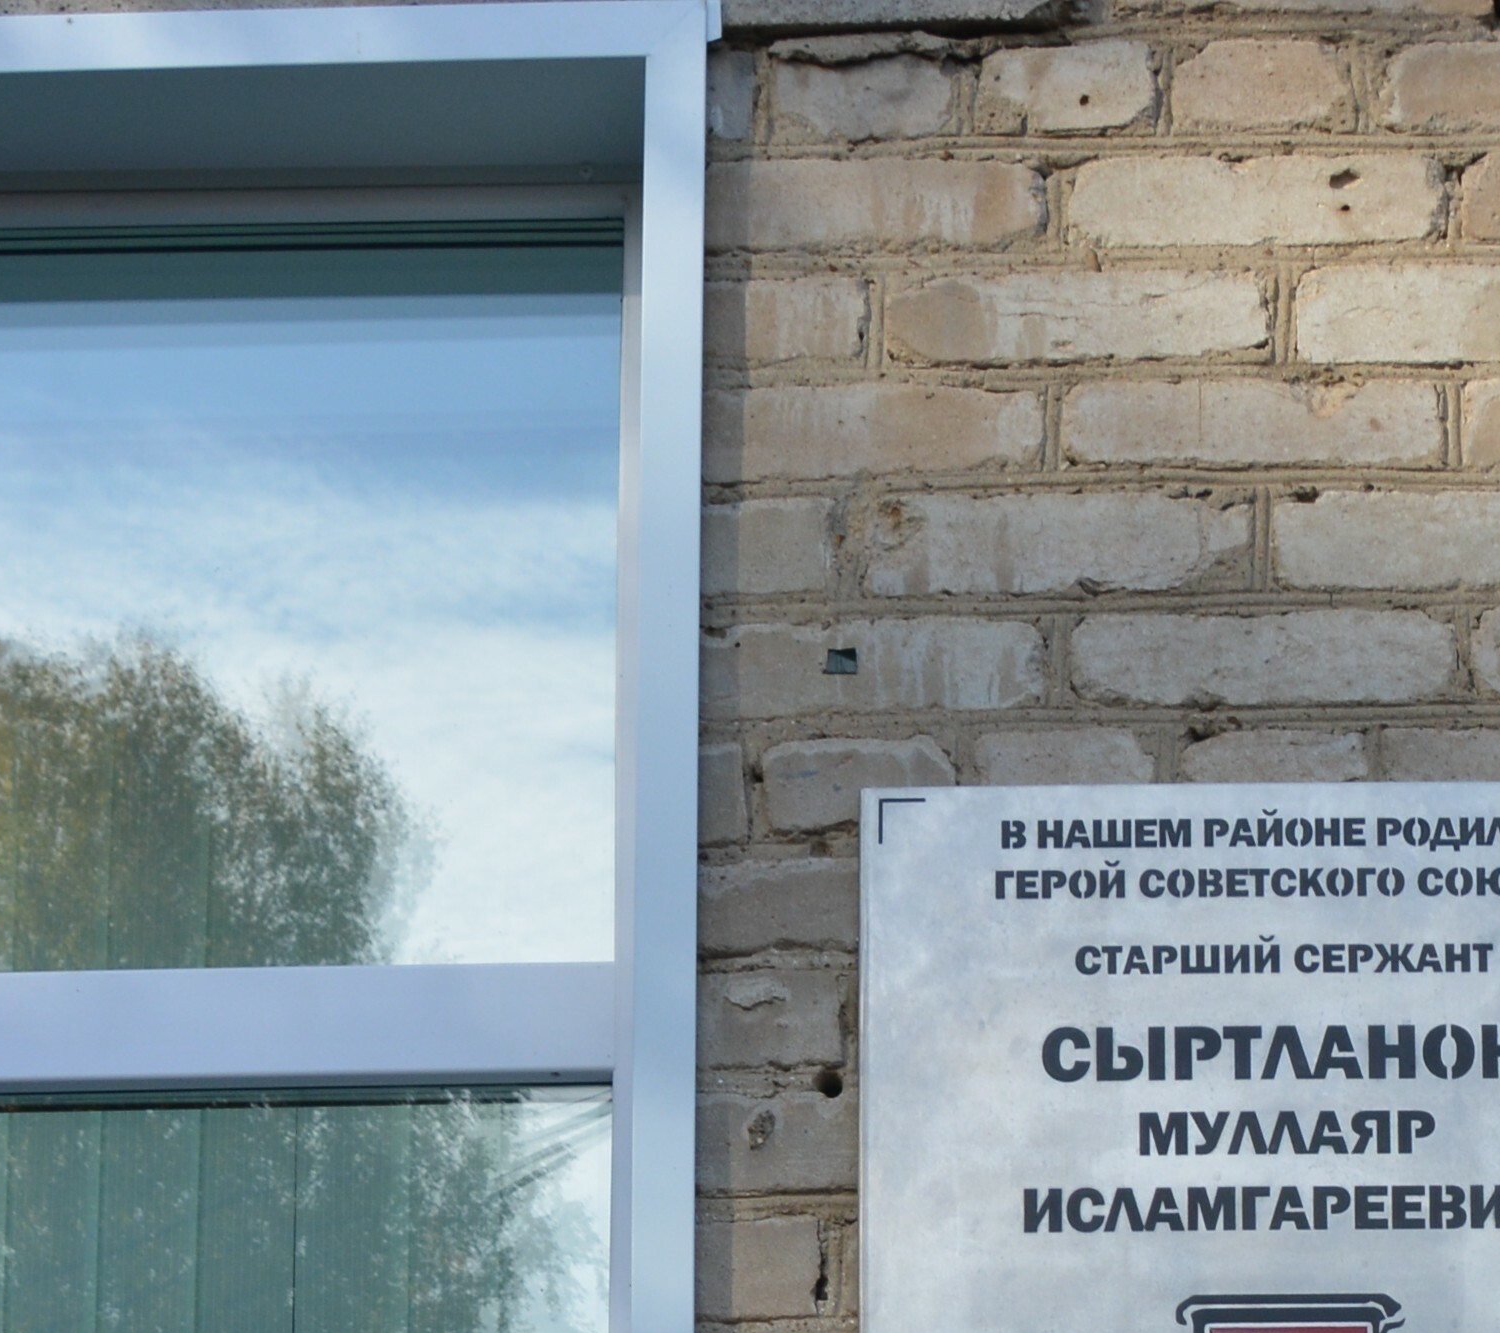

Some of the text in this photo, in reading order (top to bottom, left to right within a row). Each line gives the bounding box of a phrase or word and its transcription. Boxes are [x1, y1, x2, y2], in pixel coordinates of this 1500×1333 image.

[1001, 820, 1027, 850] В
[1037, 818, 1192, 849] НАШЕМ
[1203, 809, 1367, 848] РАЙОНЕ
[995, 860, 1126, 900] ГЕРОЙ
[1139, 867, 1405, 899] СОВЕТСКОГО
[1075, 935, 1494, 976] СТАРШИЙ СЕРЖАНТ
[1139, 1110, 1436, 1156] МУЛЛАЯР
